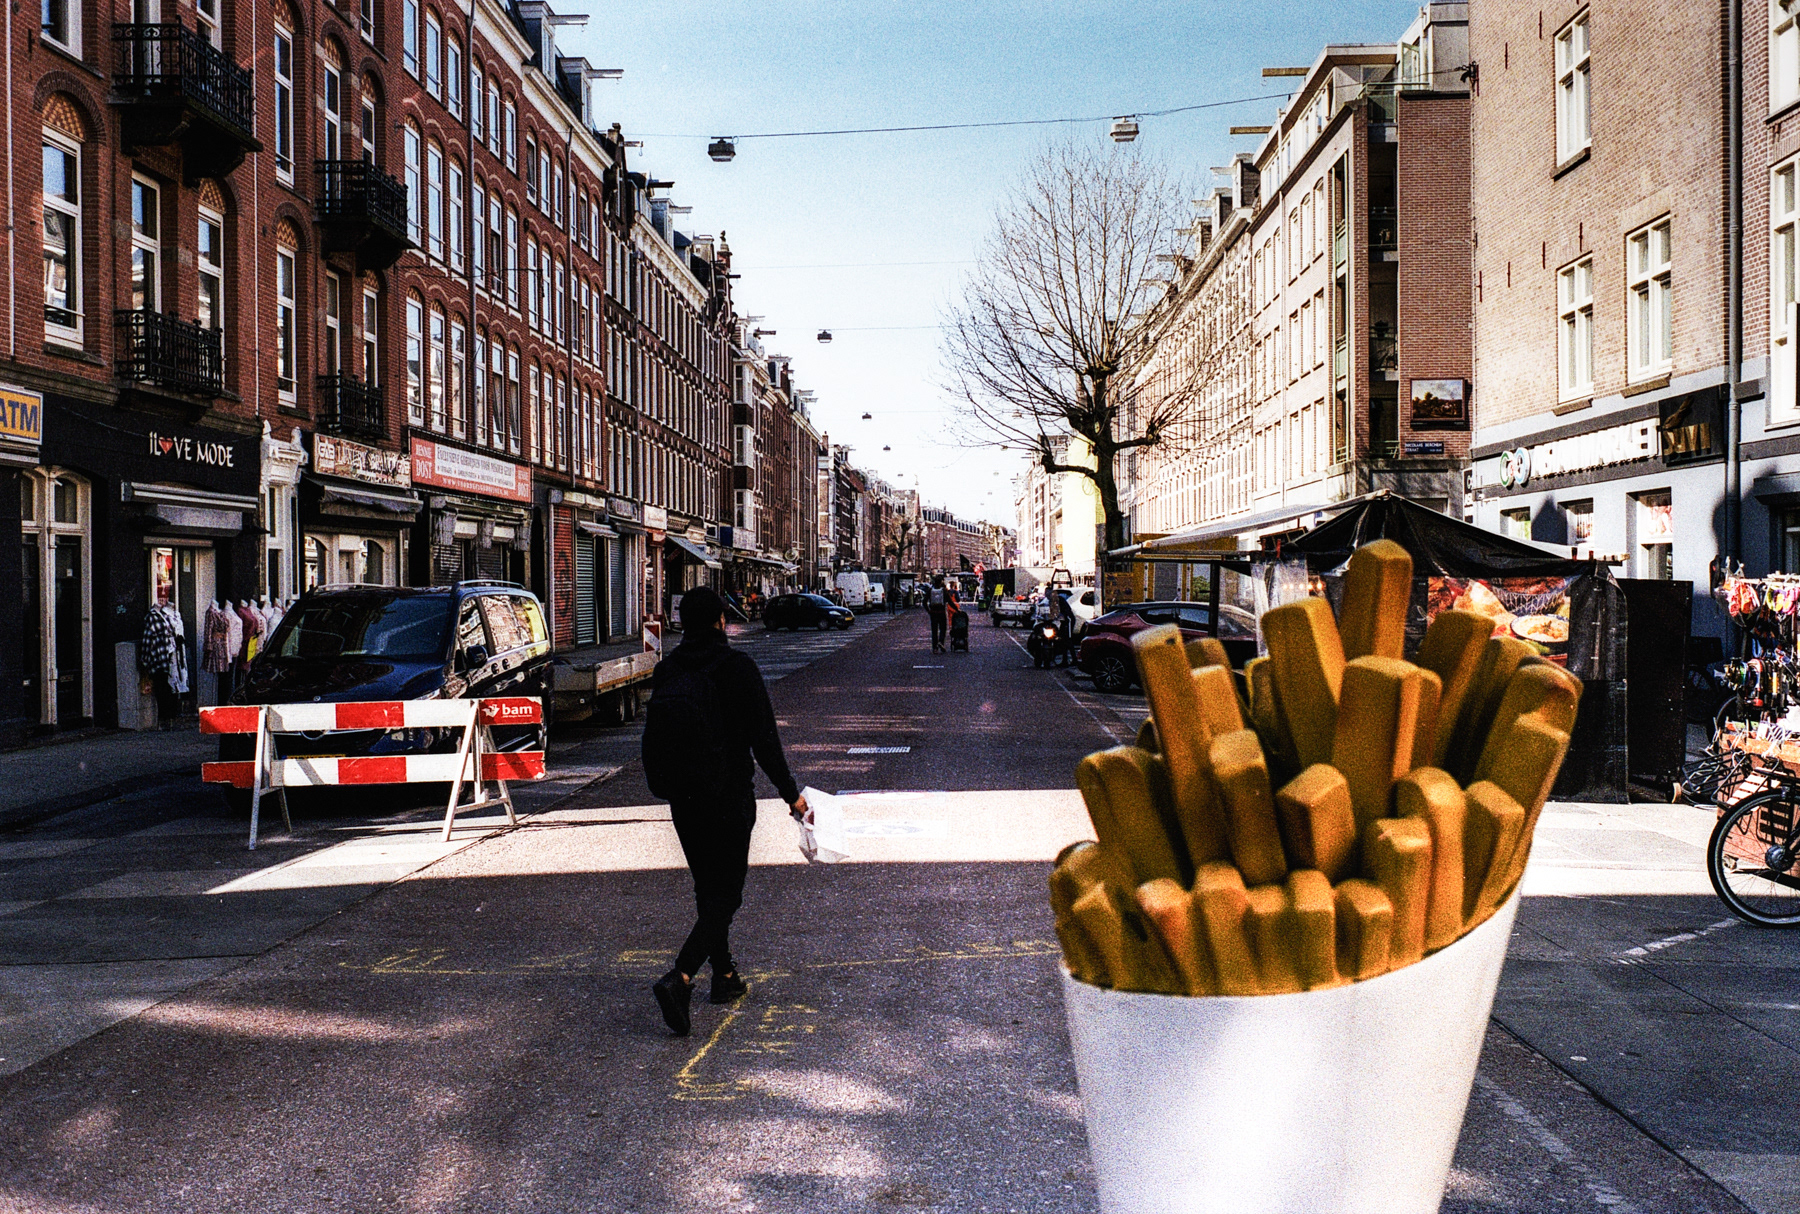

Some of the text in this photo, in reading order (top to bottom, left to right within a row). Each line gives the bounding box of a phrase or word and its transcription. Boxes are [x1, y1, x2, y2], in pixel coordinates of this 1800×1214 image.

[0, 397, 38, 433] ATM
[196, 440, 234, 468] MODE
[415, 459, 432, 479] DOST
[502, 704, 532, 715] bam
